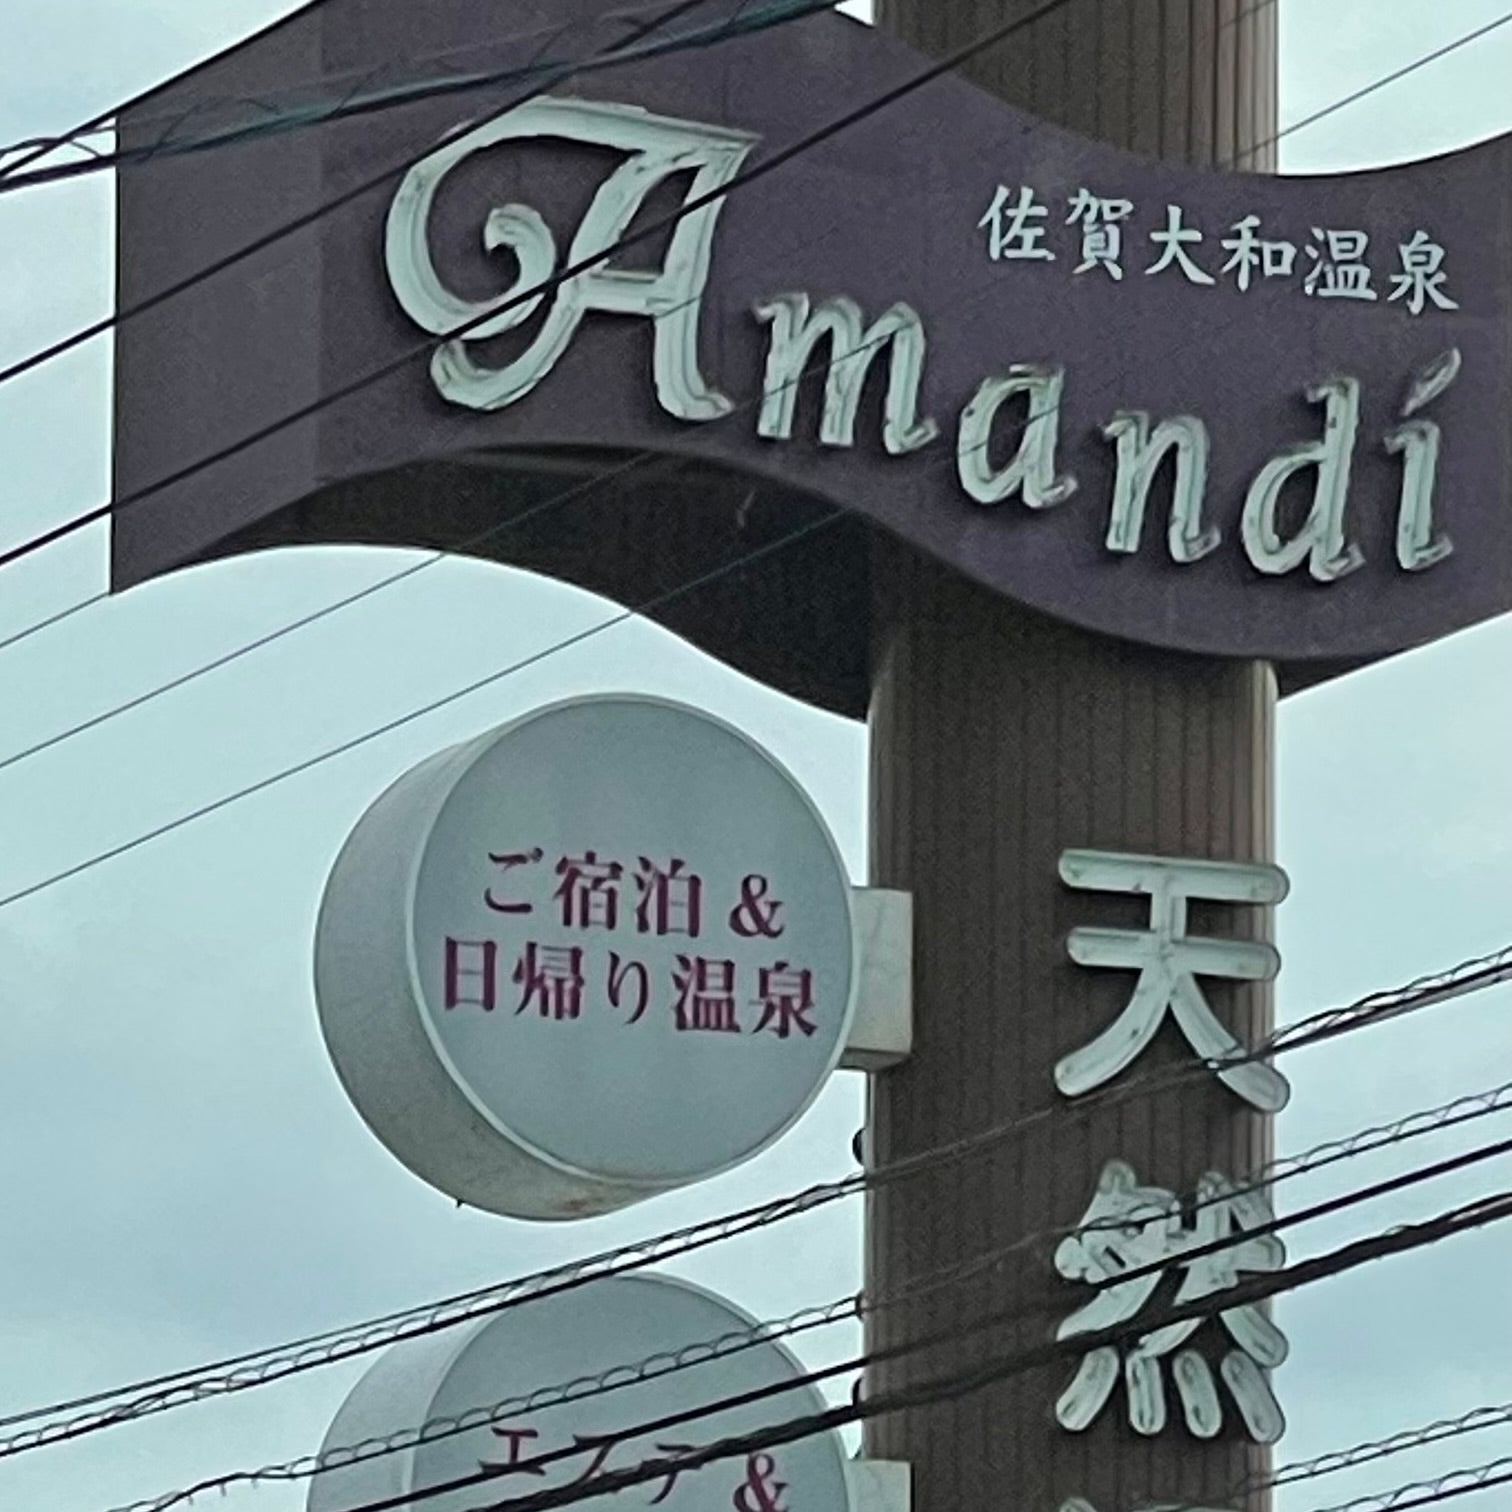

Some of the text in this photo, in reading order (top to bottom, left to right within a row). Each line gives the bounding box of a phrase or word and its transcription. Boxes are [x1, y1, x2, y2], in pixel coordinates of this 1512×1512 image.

[978, 184, 1460, 317] 佐賀大和温泉
[442, 935, 819, 1040] 日帰り温泉
